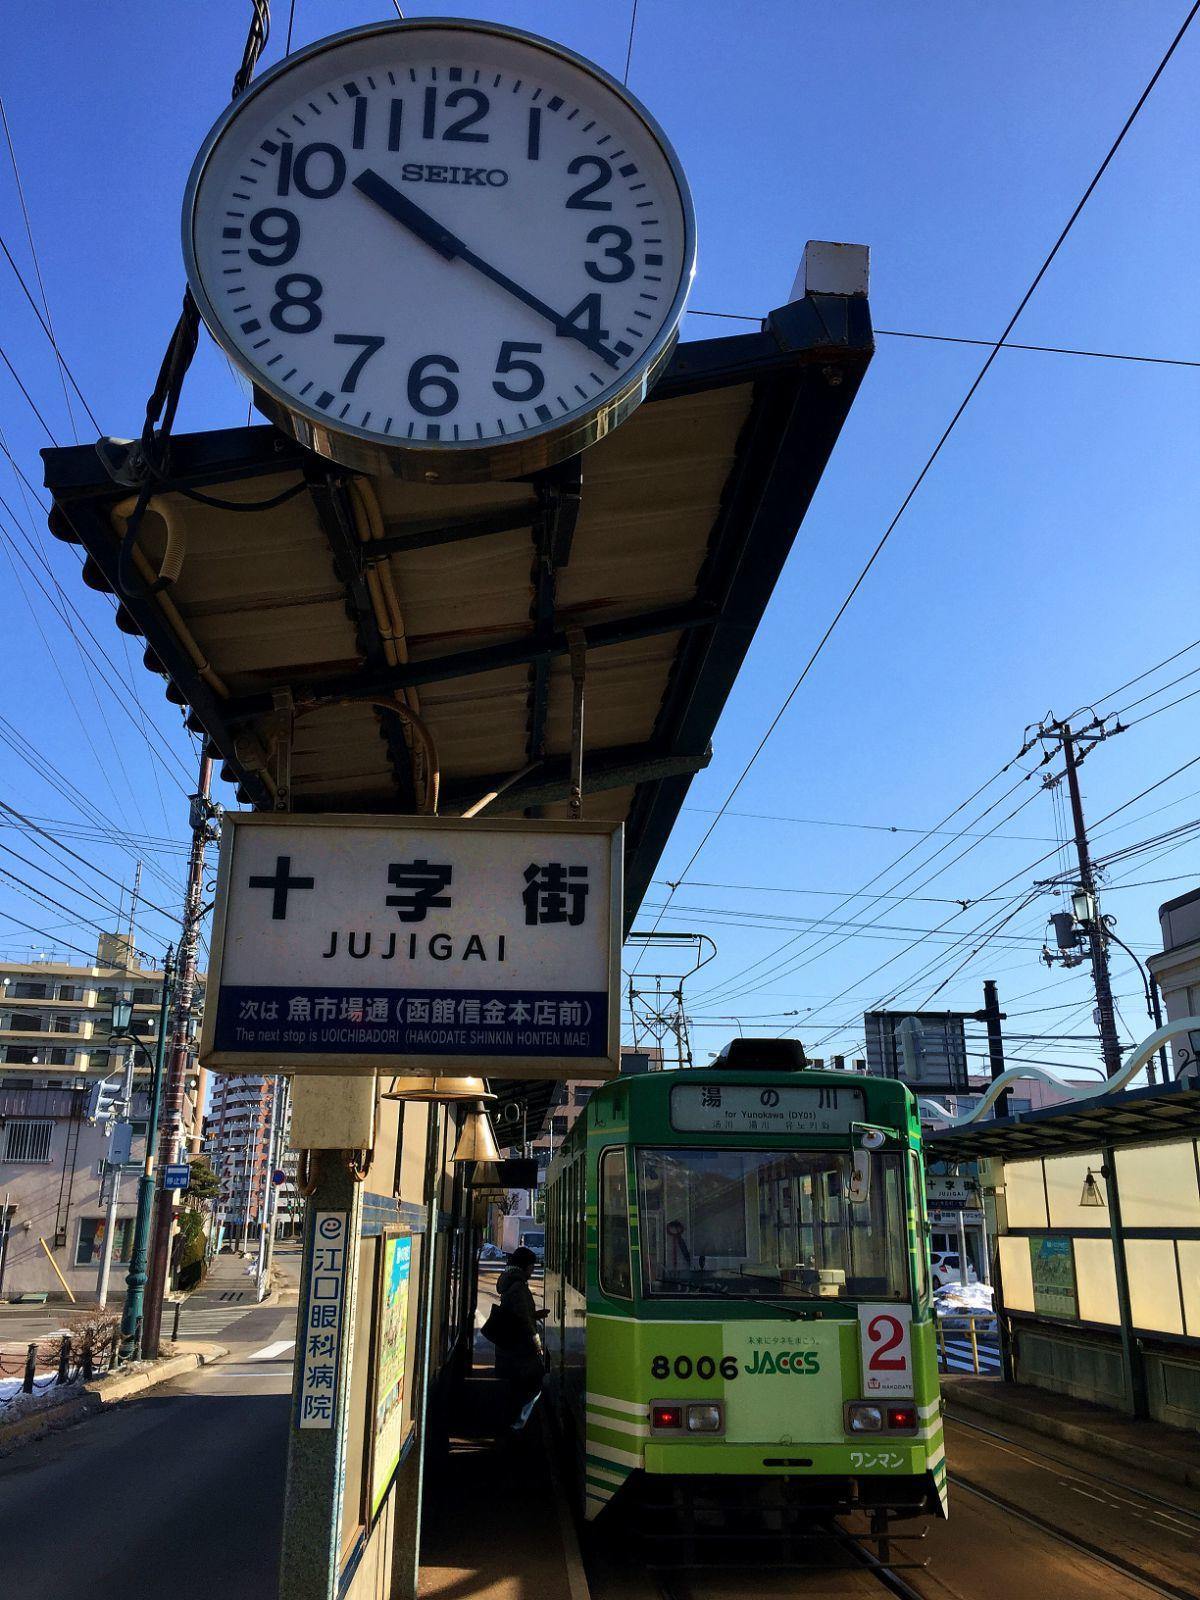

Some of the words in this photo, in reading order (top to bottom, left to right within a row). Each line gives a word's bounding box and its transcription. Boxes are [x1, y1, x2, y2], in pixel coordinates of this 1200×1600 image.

[352, 96, 403, 151] 11
[423, 86, 490, 144] 12
[527, 107, 542, 161] 1
[276, 141, 347, 200] 10
[401, 163, 509, 188] SEIKO
[564, 155, 614, 211] 2
[247, 207, 301, 267] 9
[583, 224, 636, 284] 3
[268, 273, 323, 335] 8
[556, 293, 610, 350] 4
[333, 333, 386, 394] 7
[406, 354, 460, 418] 6
[491, 341, 546, 403] 5
[248, 855, 589, 926] 十字街
[322, 931, 506, 963] JUJIGAI
[235, 1027, 255, 1042] The
[258, 1029, 280, 1043] next
[283, 1029, 306, 1045] stop
[309, 1029, 318, 1042] is
[321, 1028, 400, 1044] UOICHIBADORI
[405, 1029, 467, 1045] (HAKODATE
[471, 1030, 514, 1045] SHINKIN
[517, 1031, 563, 1046] HONTEN
[564, 1031, 591, 1048] MAE)
[238, 1000, 280, 1021] 次は
[701, 1086, 838, 1111] 湯の川
[725, 1110, 737, 1119] for
[741, 1110, 784, 1120] Yunokawa
[303, 1247, 342, 1420] 江口眼科病院
[867, 1314, 907, 1371] 2
[650, 1354, 739, 1381] 8006
[744, 1350, 820, 1375] JACCS
[850, 1452, 904, 1468] ワンマン
